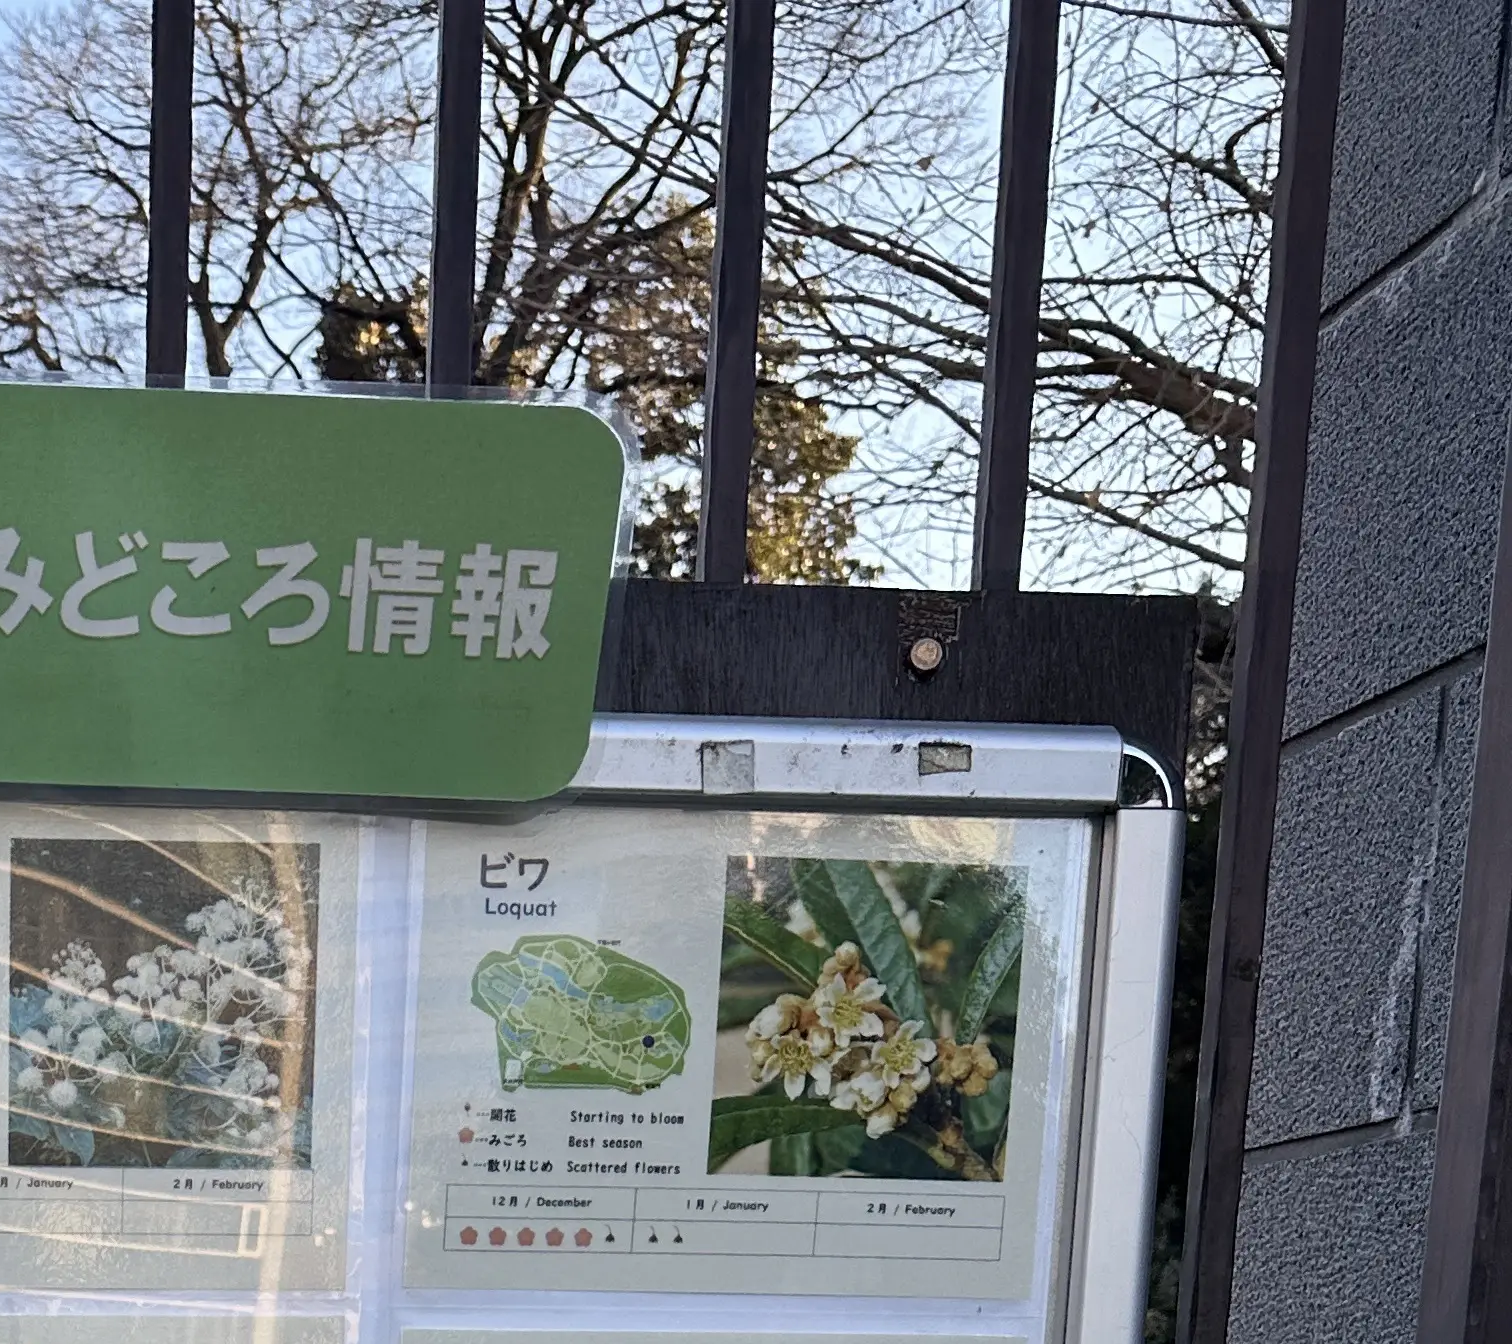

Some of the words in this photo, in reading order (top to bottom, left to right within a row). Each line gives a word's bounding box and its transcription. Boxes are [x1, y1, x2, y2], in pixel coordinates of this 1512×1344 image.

[480, 851, 550, 892] ビワ
[485, 897, 558, 921] Loquat
[570, 1110, 624, 1126] Starting
[631, 1112, 645, 1124] to
[650, 1111, 685, 1125] bloom
[568, 1135, 595, 1149] Best
[602, 1139, 643, 1149] season
[566, 1160, 628, 1174] Scattered
[634, 1161, 681, 1175] flowers
[536, 1196, 593, 1208] December
[722, 1199, 769, 1213] January
[904, 1204, 956, 1218] February
